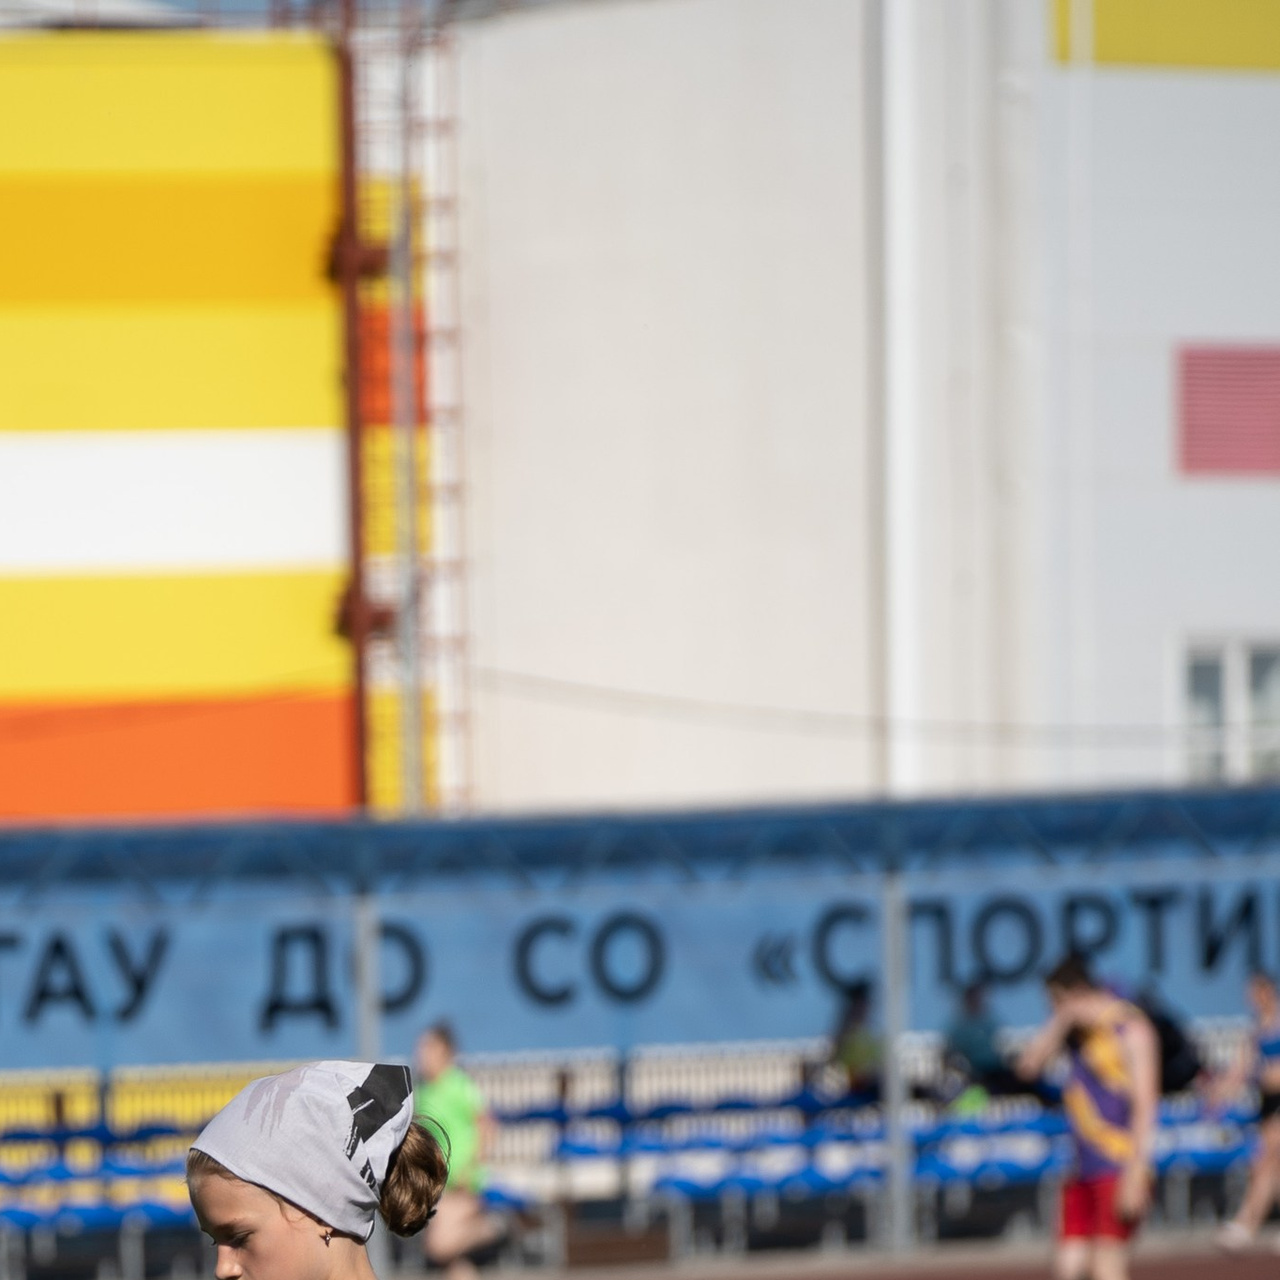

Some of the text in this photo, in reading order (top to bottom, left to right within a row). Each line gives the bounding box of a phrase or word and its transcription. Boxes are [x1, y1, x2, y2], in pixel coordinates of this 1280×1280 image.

[258, 918, 428, 1034] ДО
[511, 908, 666, 1008] СО
[752, 882, 1280, 995] «СПОРТИ
